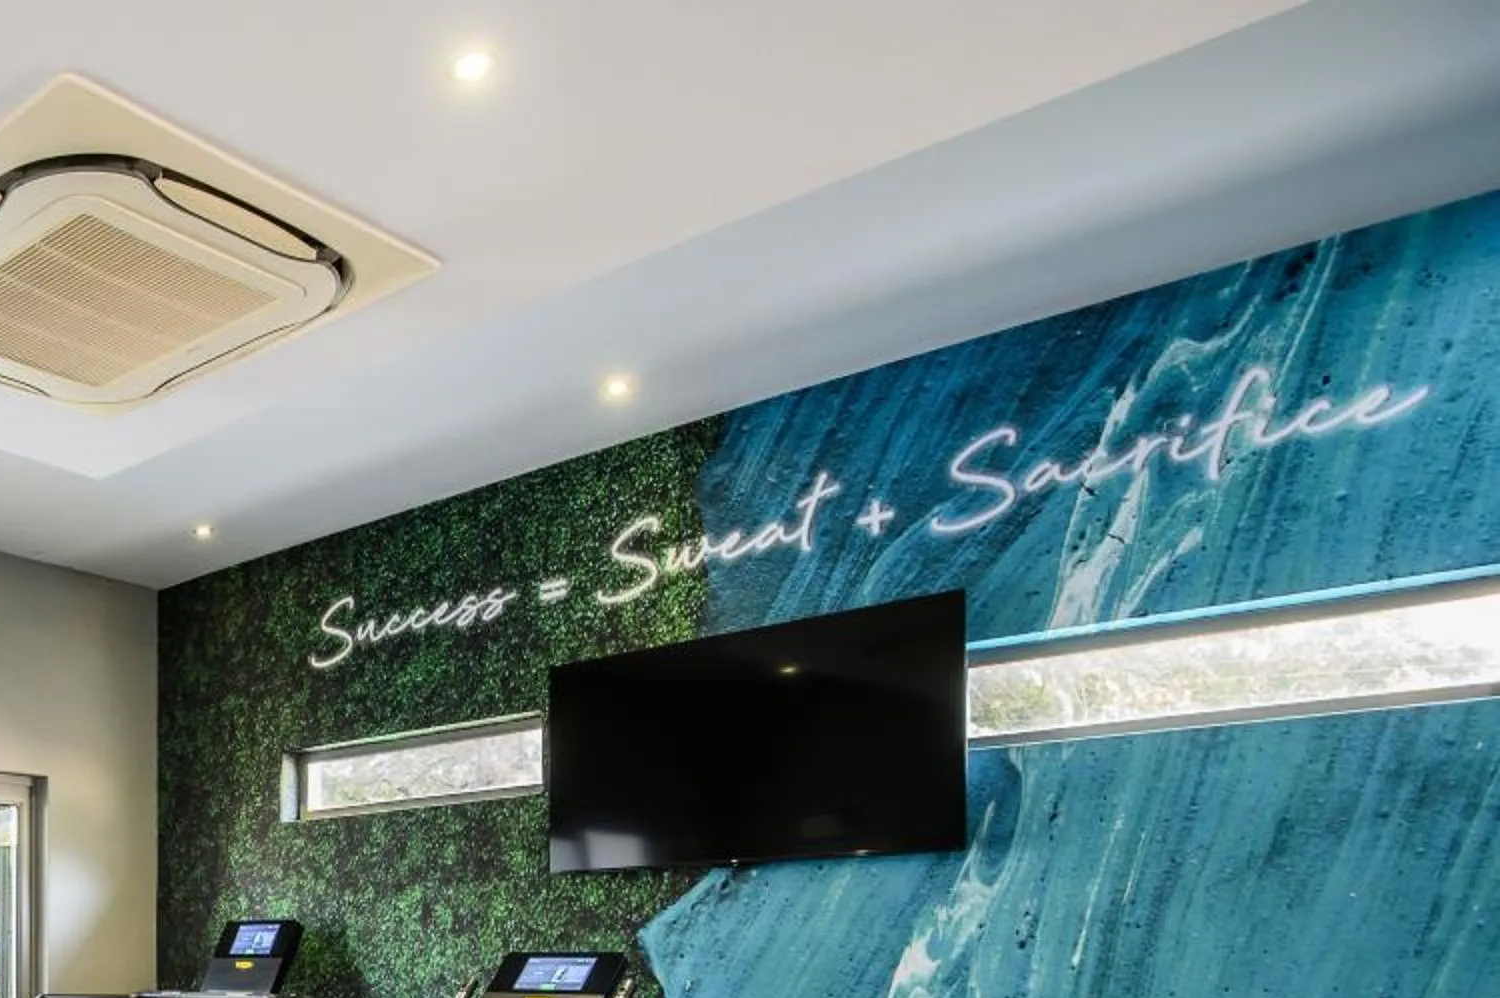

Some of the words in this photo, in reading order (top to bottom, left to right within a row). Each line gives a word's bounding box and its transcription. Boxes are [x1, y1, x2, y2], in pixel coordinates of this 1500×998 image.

[308, 588, 517, 668] Success
[539, 578, 568, 601] =
[597, 471, 841, 604] Sweat
[855, 498, 895, 536] +
[931, 367, 1430, 533] Sacrifice
